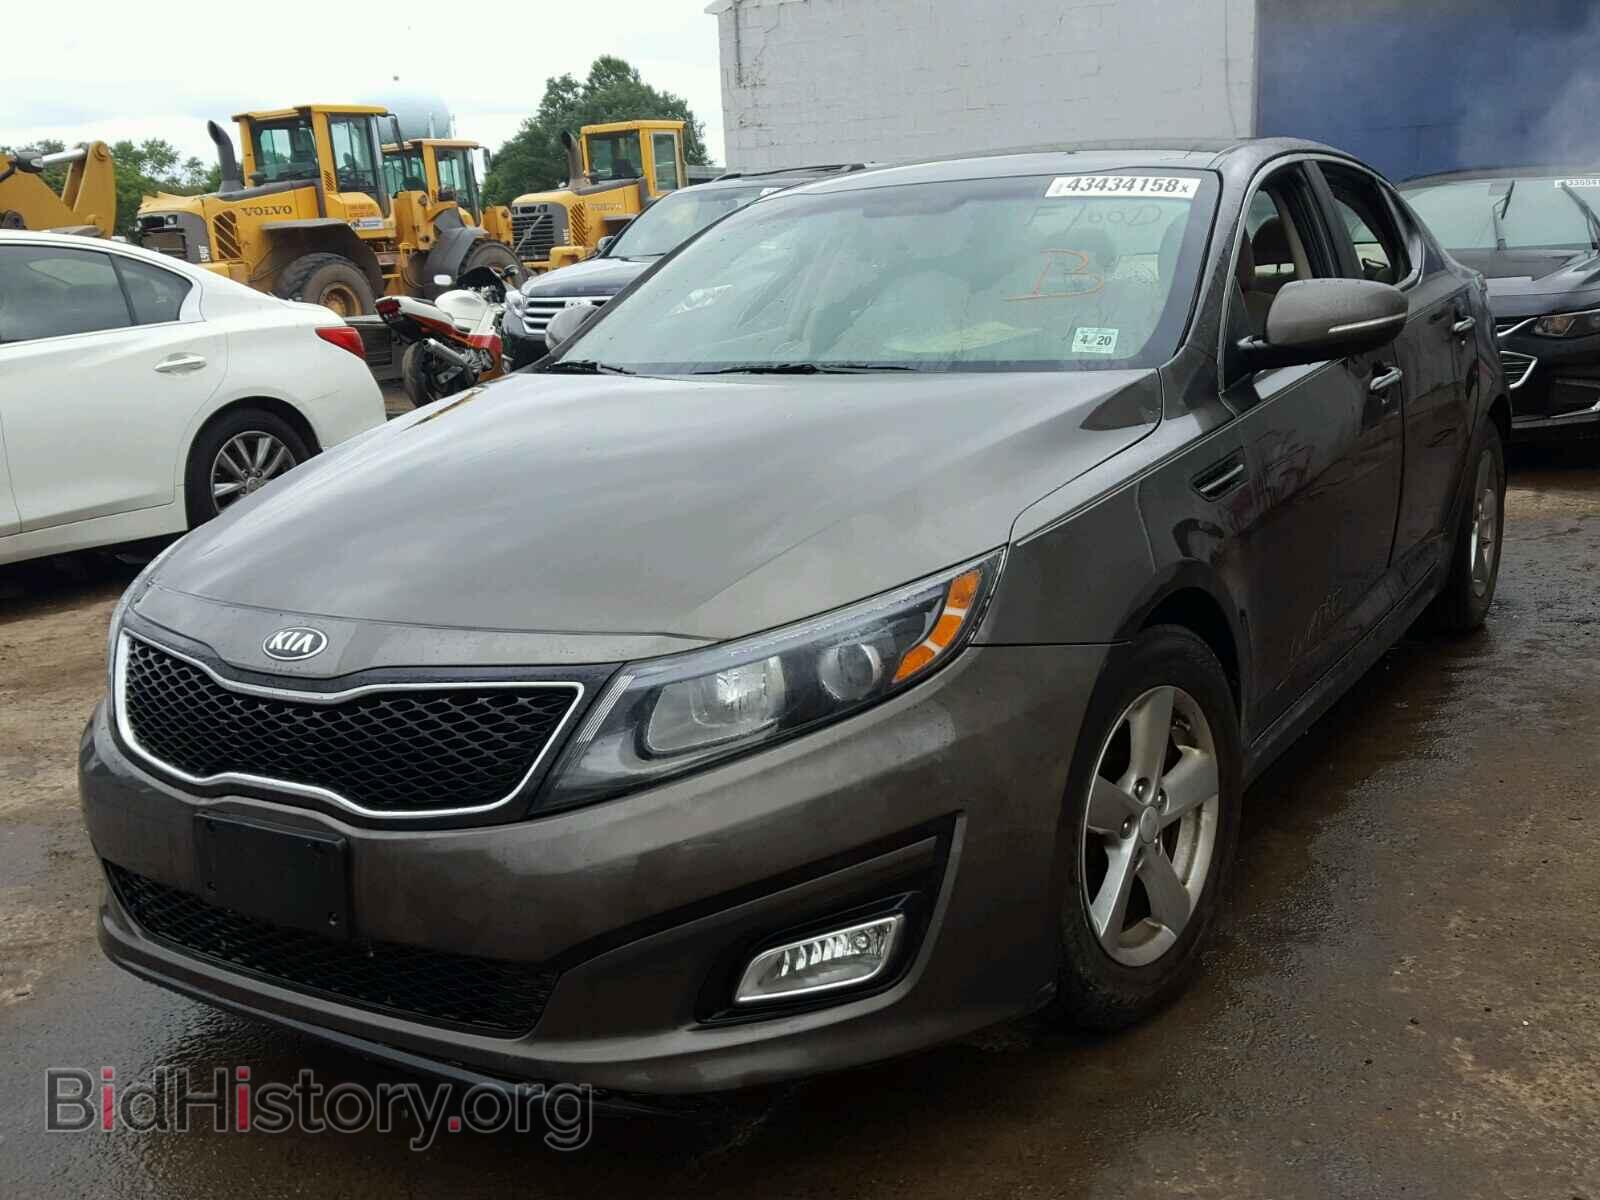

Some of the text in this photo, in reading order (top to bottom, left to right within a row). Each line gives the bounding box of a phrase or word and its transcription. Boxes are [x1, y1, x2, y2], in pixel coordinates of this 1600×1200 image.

[240, 205, 293, 216] VOLVO
[1096, 335, 1113, 346] 20
[268, 631, 315, 653] KIA
